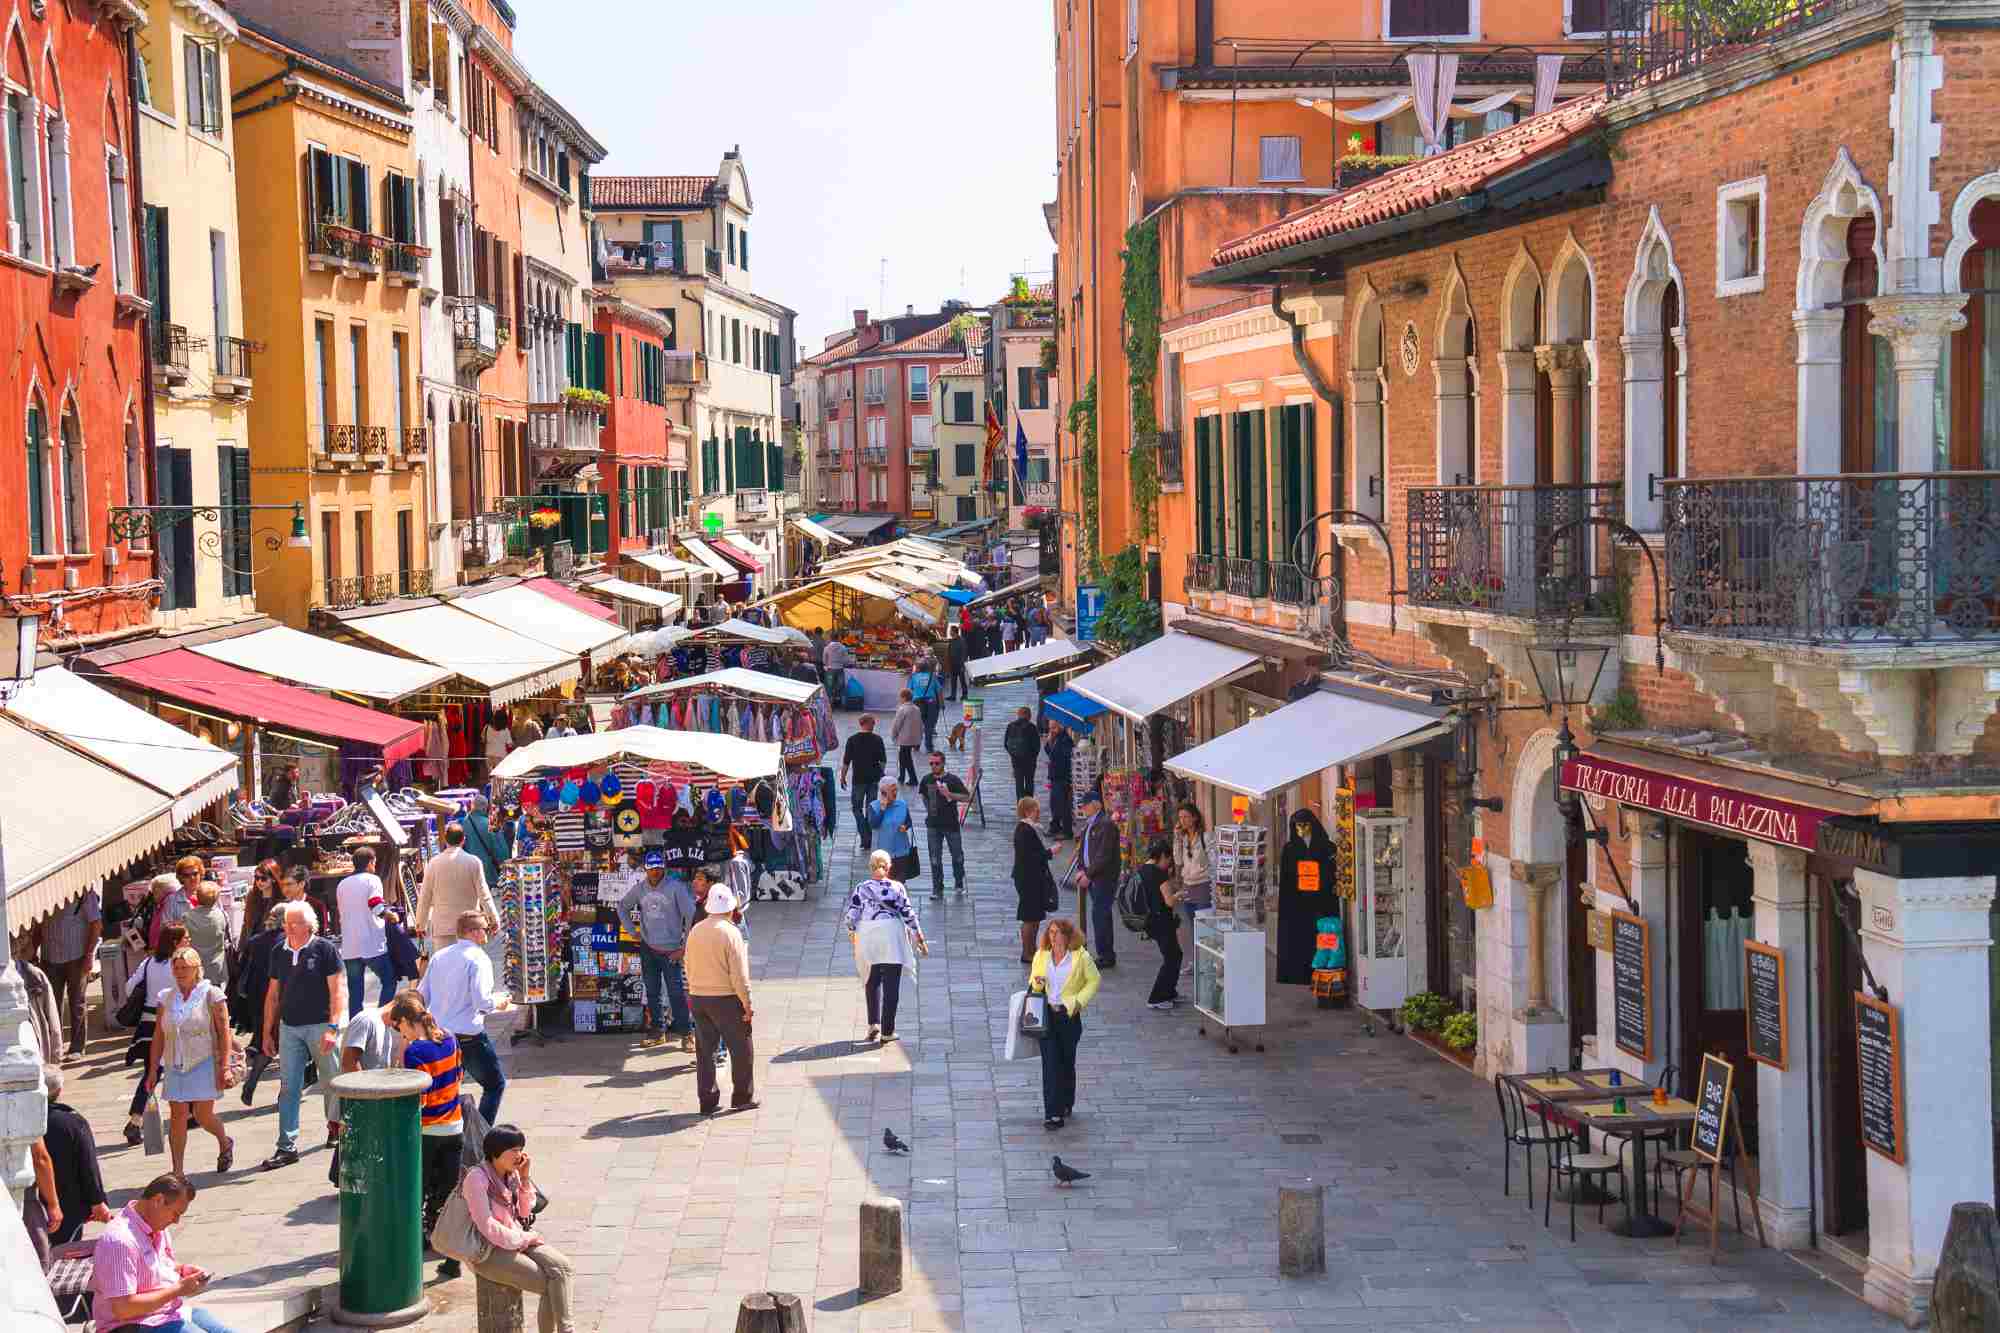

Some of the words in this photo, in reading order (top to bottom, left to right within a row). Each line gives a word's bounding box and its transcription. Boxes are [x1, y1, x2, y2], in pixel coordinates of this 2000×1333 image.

[1575, 763, 1649, 806] TRATTORIA
[1660, 784, 1697, 817] ALLA
[1709, 794, 1799, 844] PALAZZINA
